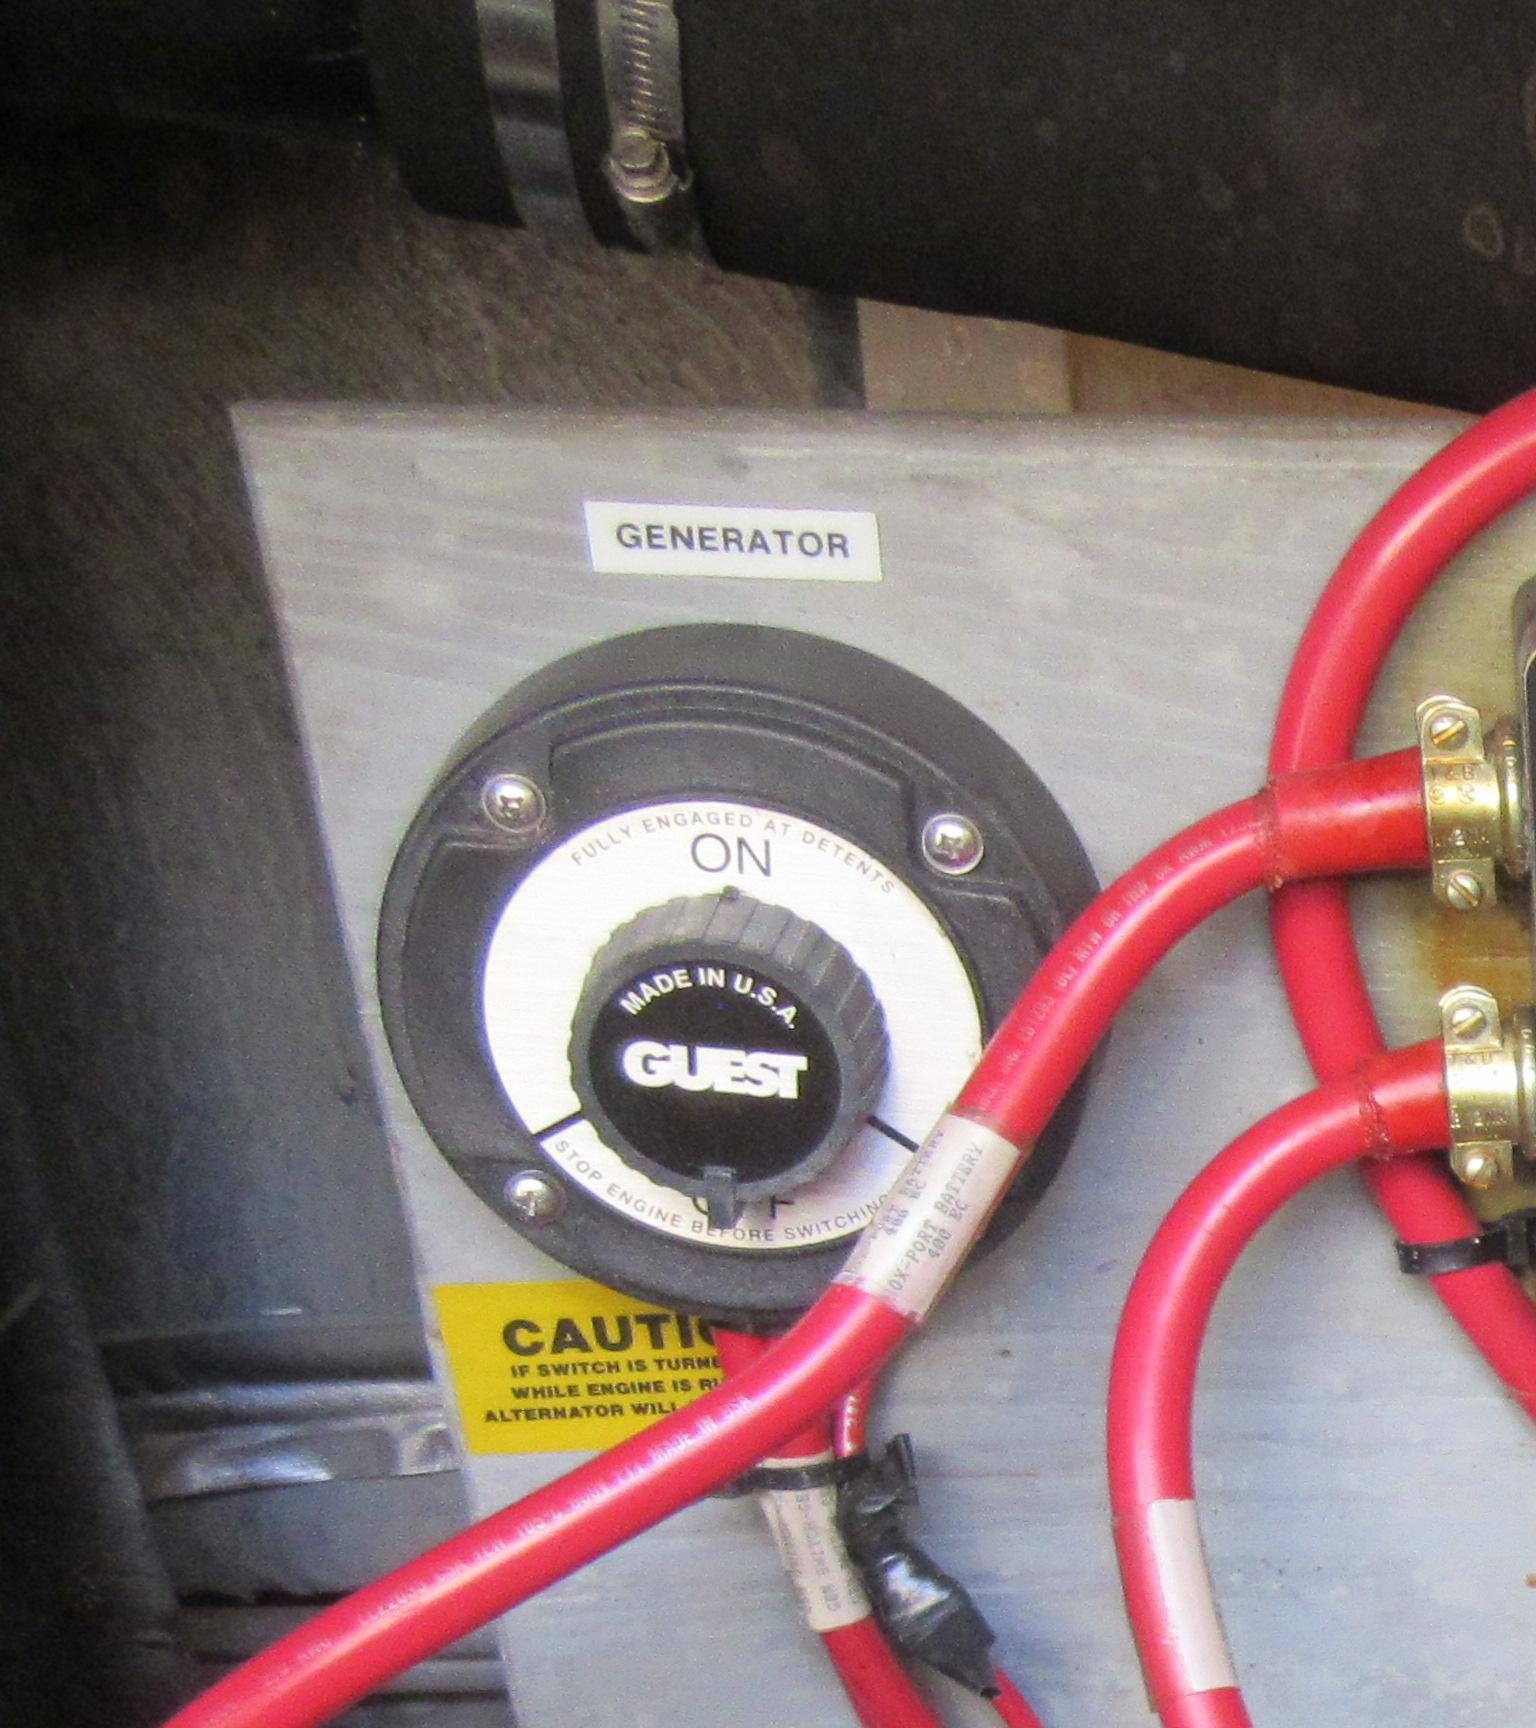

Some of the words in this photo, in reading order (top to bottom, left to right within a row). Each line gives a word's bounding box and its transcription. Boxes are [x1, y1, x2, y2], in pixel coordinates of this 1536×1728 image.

[616, 523, 850, 559] GENERATOR
[571, 822, 635, 867] FULLY
[641, 811, 754, 834] ENGAGED
[764, 817, 792, 837] AT
[802, 829, 897, 895] DETENTS
[690, 832, 772, 878] ON
[619, 967, 694, 1017] MADE
[698, 967, 727, 989] IN
[732, 973, 799, 1030] U.S.A.
[620, 1040, 808, 1100] GUEST
[553, 1138, 601, 1183] STOP
[606, 1182, 685, 1229] ENGINE
[690, 1219, 777, 1243] BEFORE
[887, 1218, 939, 1292] OX-PORT
[933, 1140, 984, 1216] BATTERY
[510, 1385, 582, 1401] WHILE
[587, 1381, 666, 1398] ENGINE
[672, 1379, 692, 1393] IS
[511, 1365, 530, 1378] IF
[538, 1361, 621, 1378] SWITCH
[627, 1359, 648, 1373] IS
[484, 1404, 623, 1424] ALTERNATOR
